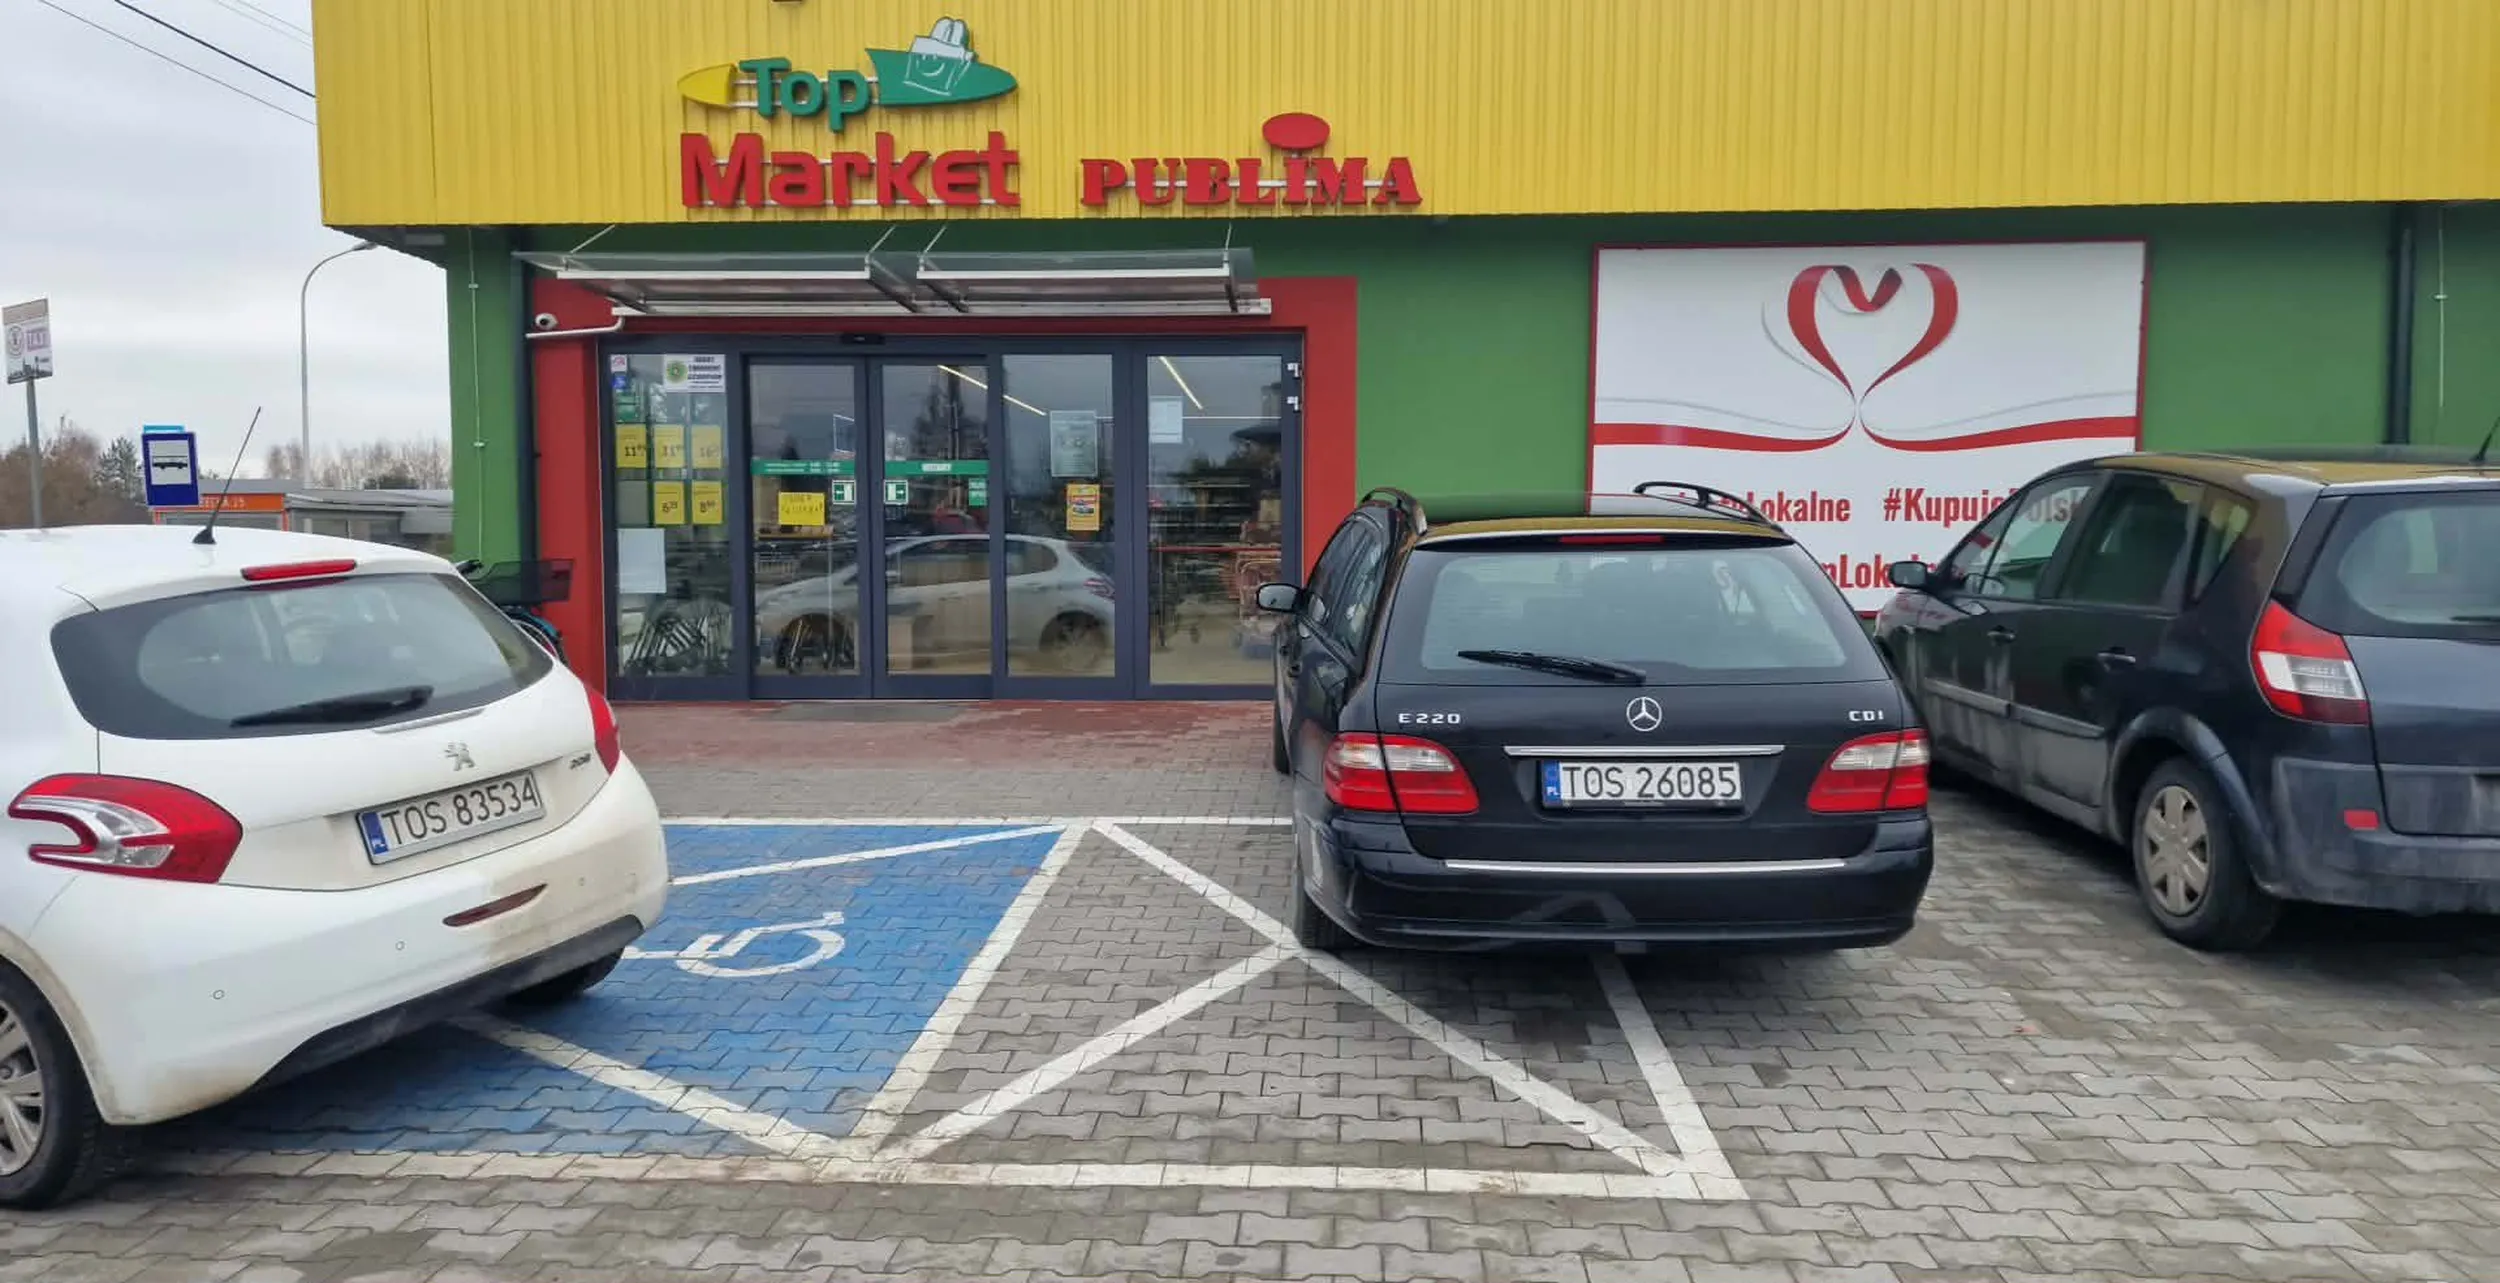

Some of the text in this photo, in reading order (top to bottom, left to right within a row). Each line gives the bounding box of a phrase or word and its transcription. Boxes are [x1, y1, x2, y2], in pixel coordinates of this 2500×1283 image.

[738, 57, 872, 133] Top
[680, 131, 1021, 208] Market
[1848, 709, 1884, 722] CDI
[381, 776, 538, 845] TOS 83534
[1562, 766, 1736, 798] TOS 26085
